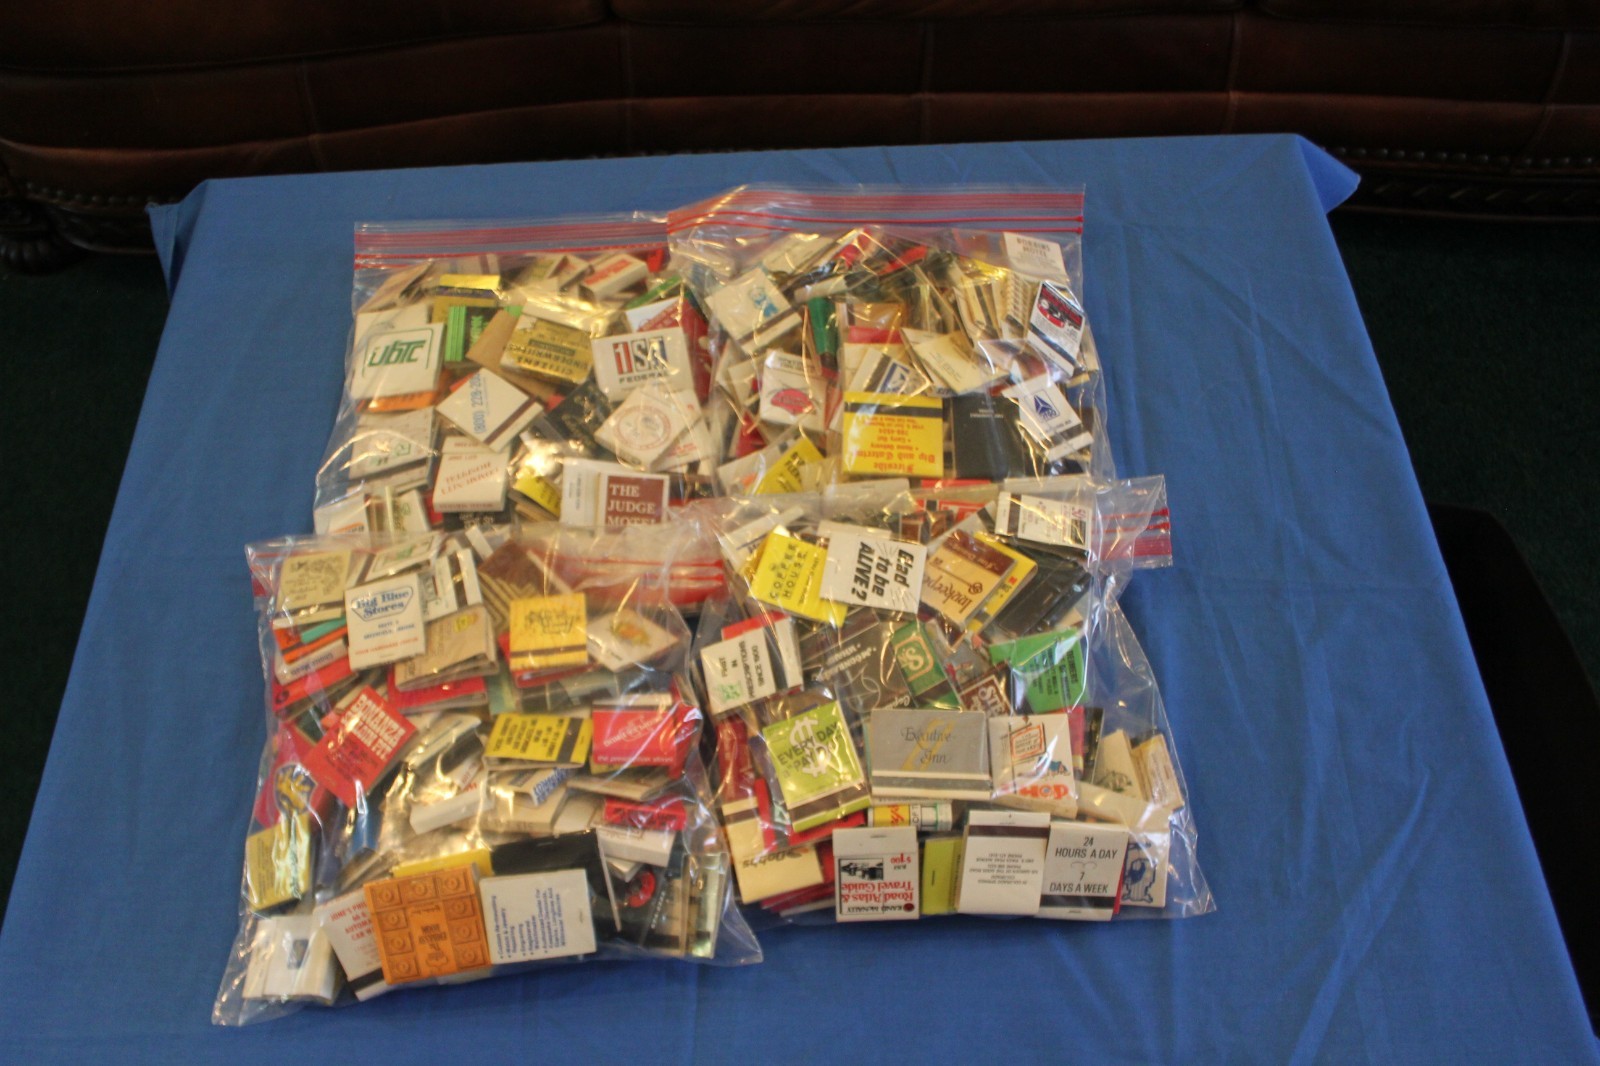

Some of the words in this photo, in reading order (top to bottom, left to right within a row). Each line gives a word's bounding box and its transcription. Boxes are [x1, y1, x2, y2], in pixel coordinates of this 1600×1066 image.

[609, 484, 640, 498] THE
[607, 500, 656, 514] JUDGE
[875, 556, 890, 571] to
[769, 543, 798, 600] COFFEE
[783, 551, 807, 598] HOUSE
[852, 541, 873, 602] ALIVE?
[871, 573, 889, 597] be
[351, 694, 406, 745] BONANZA
[777, 735, 815, 766] EVERY
[817, 720, 840, 742] DAY
[1083, 836, 1094, 847] 24
[1055, 847, 1087, 859] HOURS
[1090, 849, 1098, 858] A
[1098, 849, 1118, 860] DAY
[1080, 872, 1085, 882] 7
[841, 881, 875, 892] Guide
[878, 881, 914, 891] Travel
[1050, 882, 1074, 893] DAYS
[1075, 883, 1082, 893] A
[1083, 884, 1109, 894] WEEK
[850, 891, 881, 902] Atlas
[882, 891, 914, 902] Road
